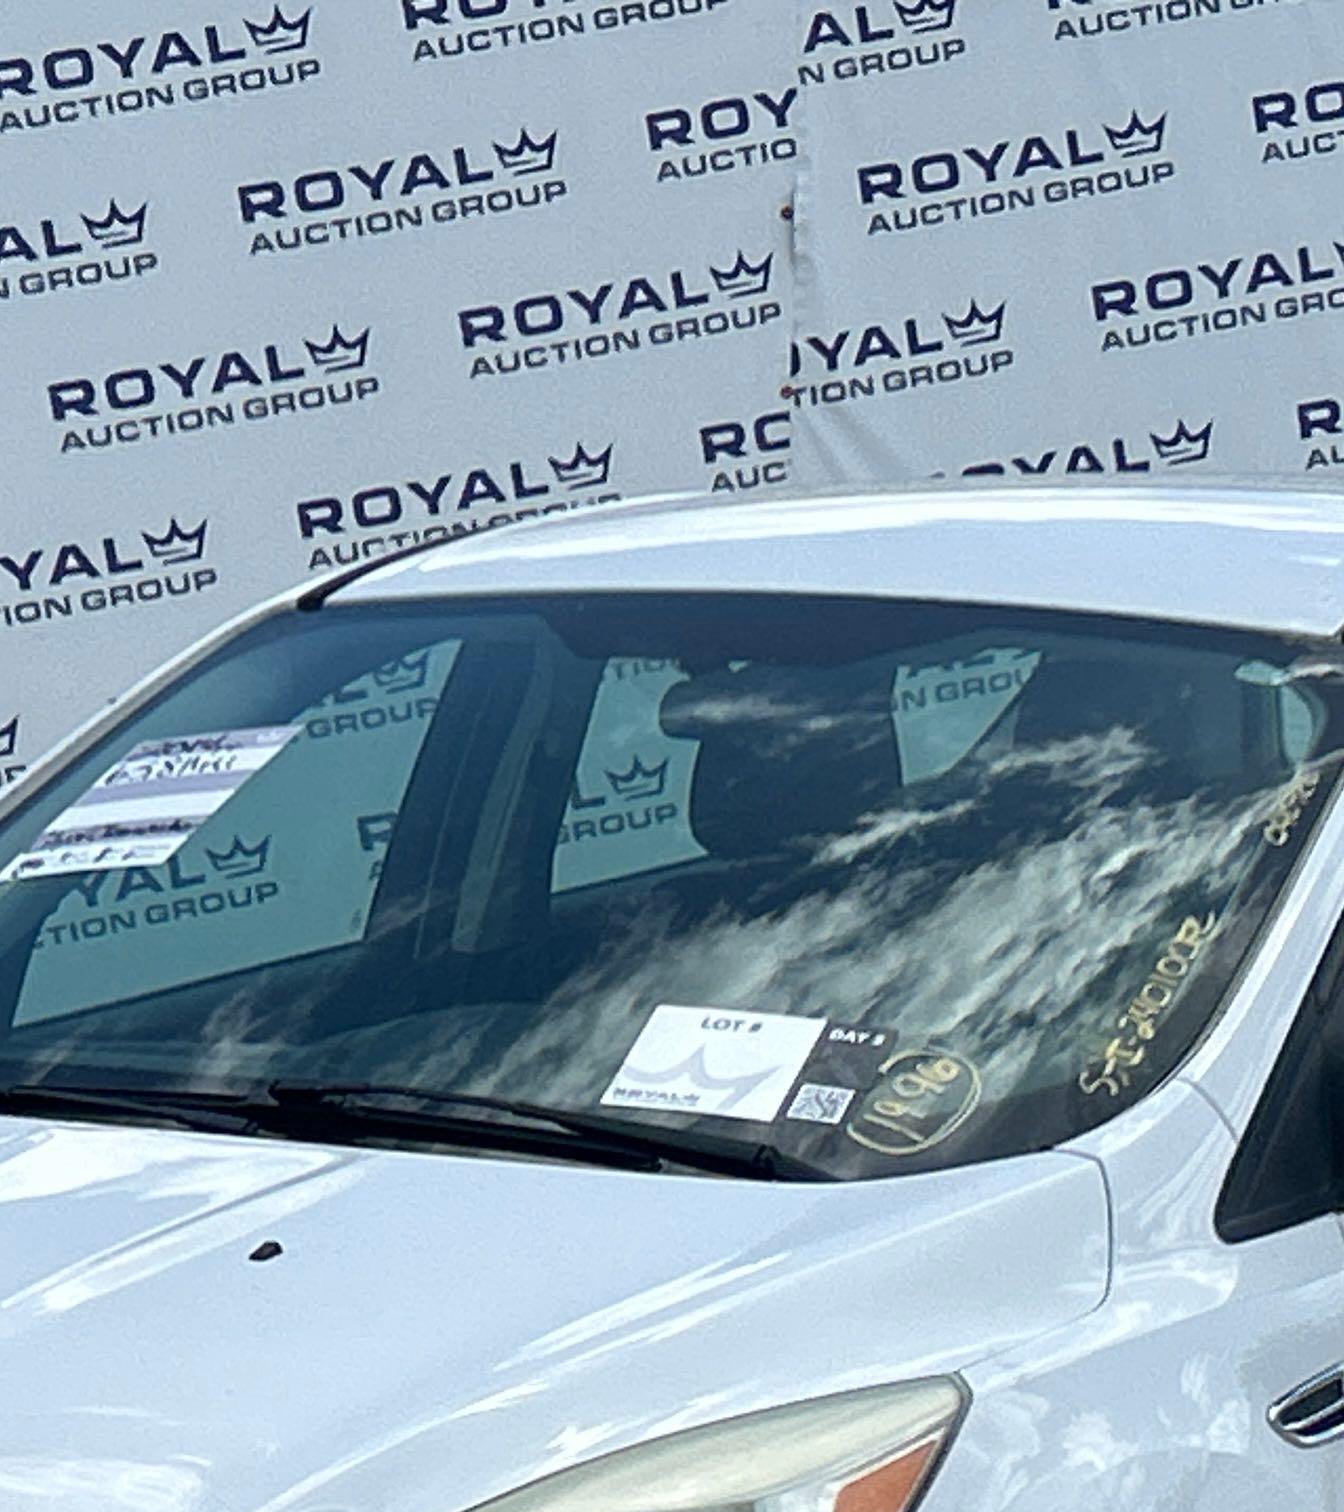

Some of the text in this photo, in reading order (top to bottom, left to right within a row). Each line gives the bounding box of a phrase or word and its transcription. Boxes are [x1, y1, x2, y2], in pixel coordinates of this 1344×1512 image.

[413, 18, 585, 62] AUCTION
[833, 39, 965, 80] GROUP
[0, 59, 320, 133] AUCTION GROUP
[238, 147, 494, 224] ROYAL
[857, 130, 1104, 205] ROYAL
[868, 162, 1174, 235] AUCTION GROUP
[250, 180, 567, 256] AUCTION GROUP
[19, 253, 157, 295] GROUP
[458, 271, 710, 348] ROYAL
[1091, 246, 1335, 322] ROYAL
[470, 302, 781, 379] AUCTION GROUP
[1102, 303, 1266, 352] AUCTION
[47, 345, 305, 421] ROYAL
[882, 350, 1013, 392] GROUP
[61, 377, 379, 453] AUCTION GROUP
[297, 462, 551, 540] ROYAL
[81, 568, 217, 611] GROUP
[147, 883, 279, 924] GROUP
[701, 1016, 745, 1033] LOT
